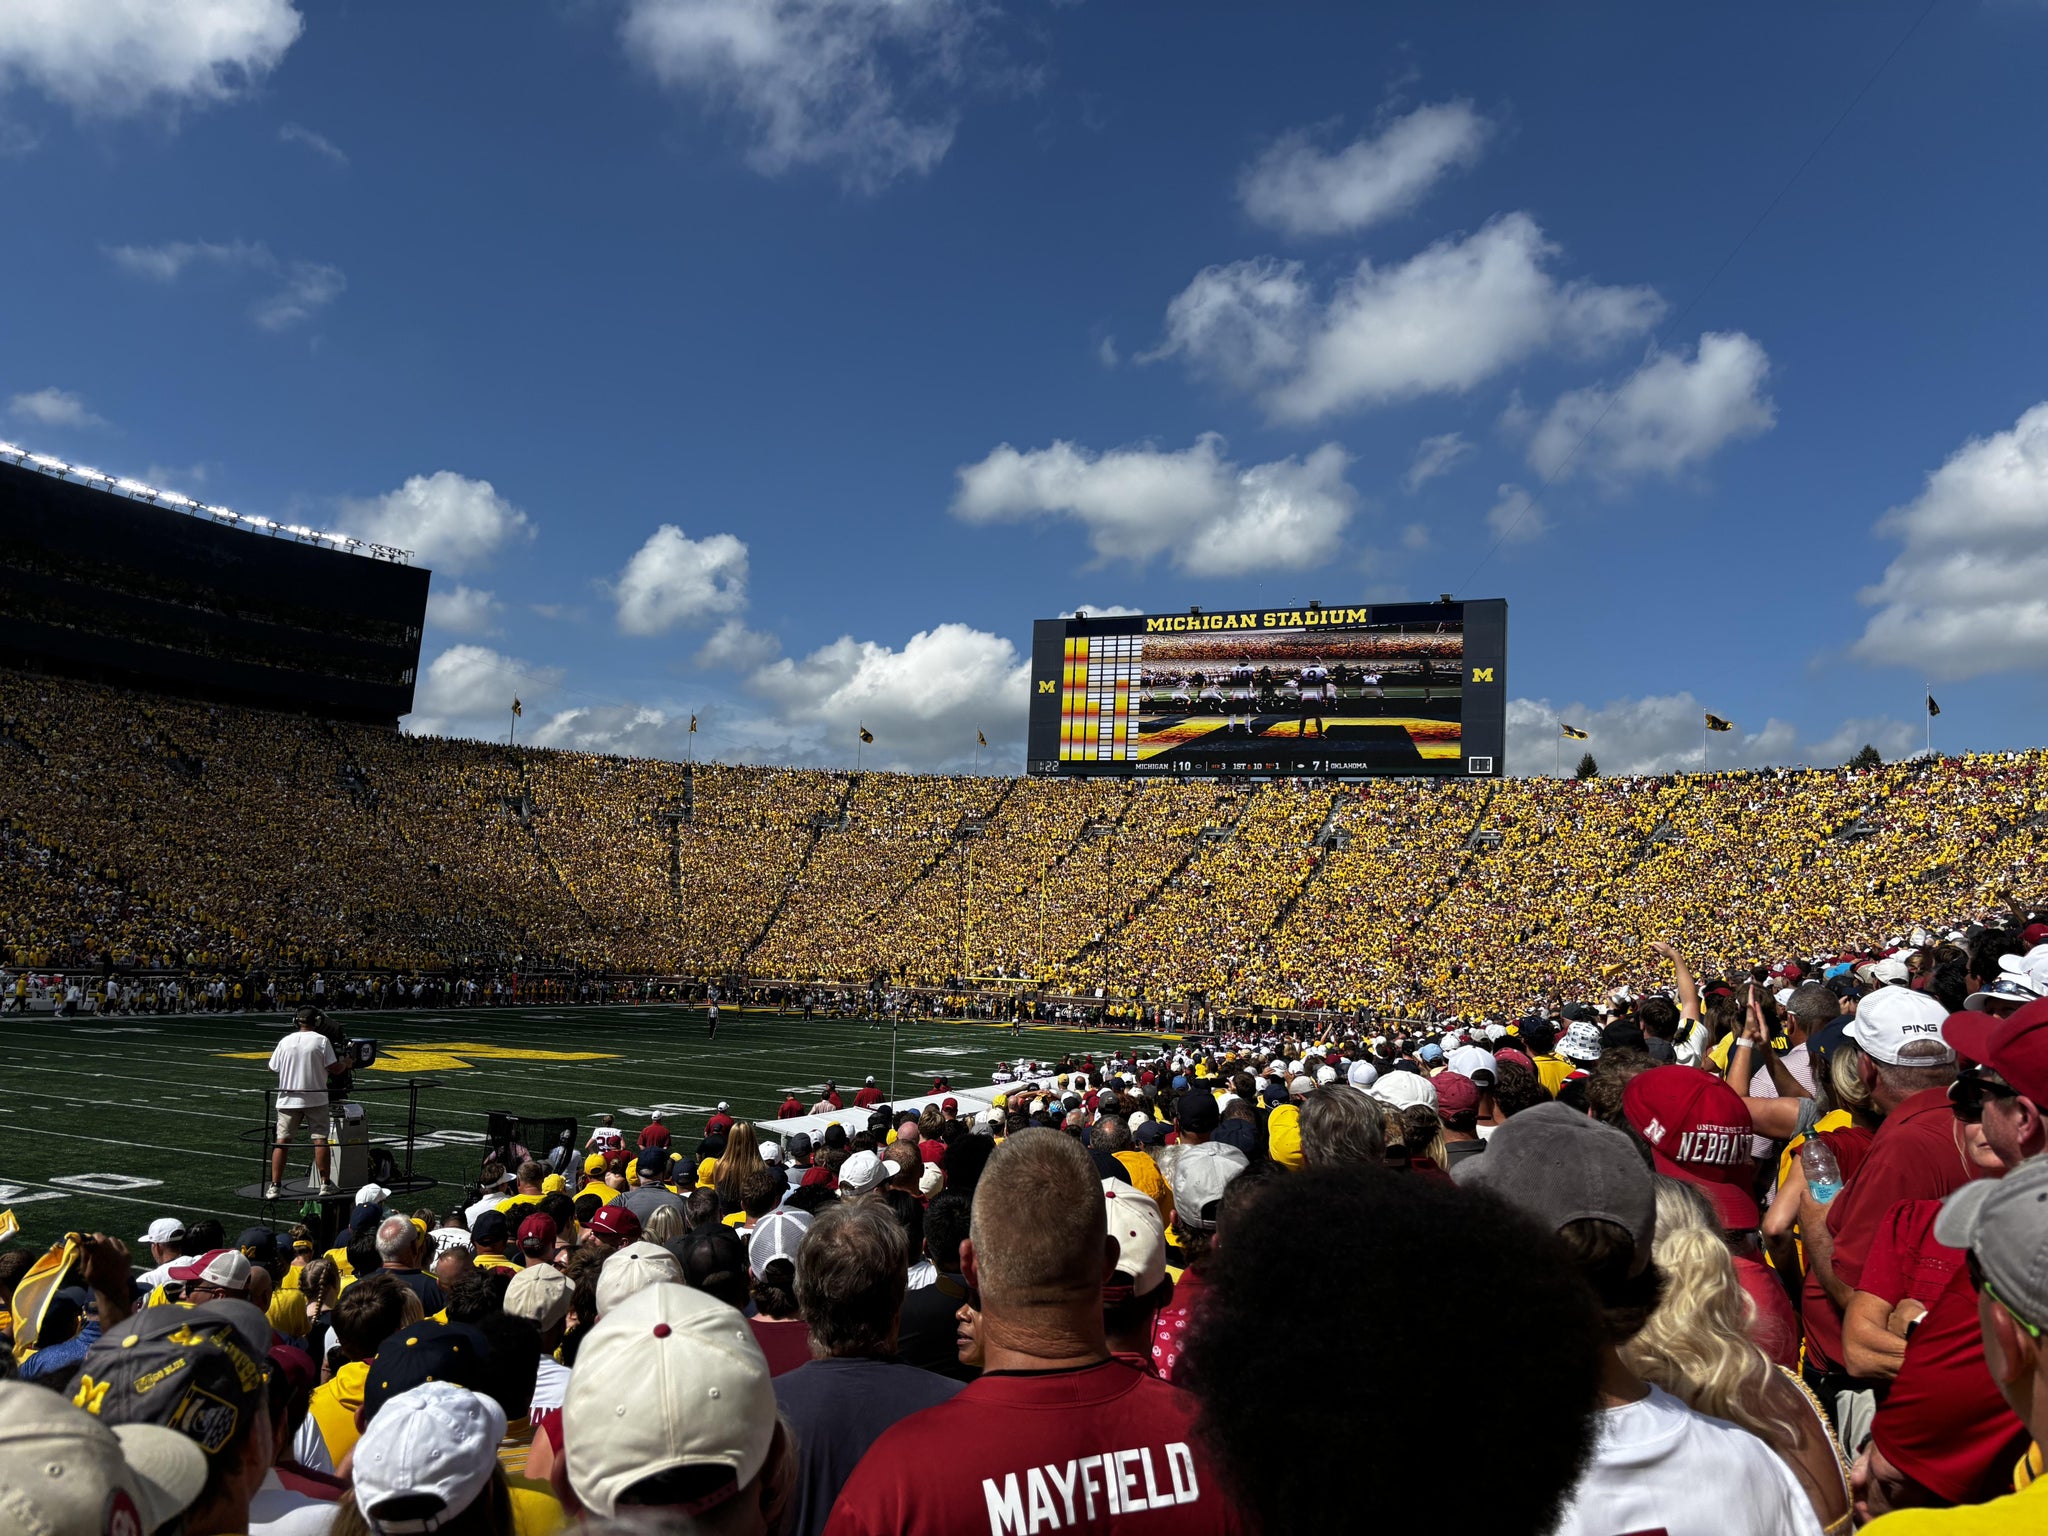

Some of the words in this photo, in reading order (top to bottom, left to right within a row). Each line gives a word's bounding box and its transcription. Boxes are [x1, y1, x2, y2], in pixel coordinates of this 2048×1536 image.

[1146, 613, 1257, 632] MICHIGAN
[1263, 608, 1367, 627] STADIUM
[1472, 667, 1494, 682] M
[1038, 680, 1056, 694] M
[1135, 762, 1169, 771] MICHIGAN
[1178, 761, 1191, 771] 10
[1233, 762, 1246, 770] 1ST
[1253, 762, 1262, 770] 10
[1312, 760, 1321, 771] 7
[1330, 762, 1368, 770] OKLAHOMA
[1902, 1023, 1938, 1035] PING
[1643, 1117, 1666, 1145] N
[73, 1374, 111, 1415] M
[982, 1442, 1199, 1536] MAYFIELD
